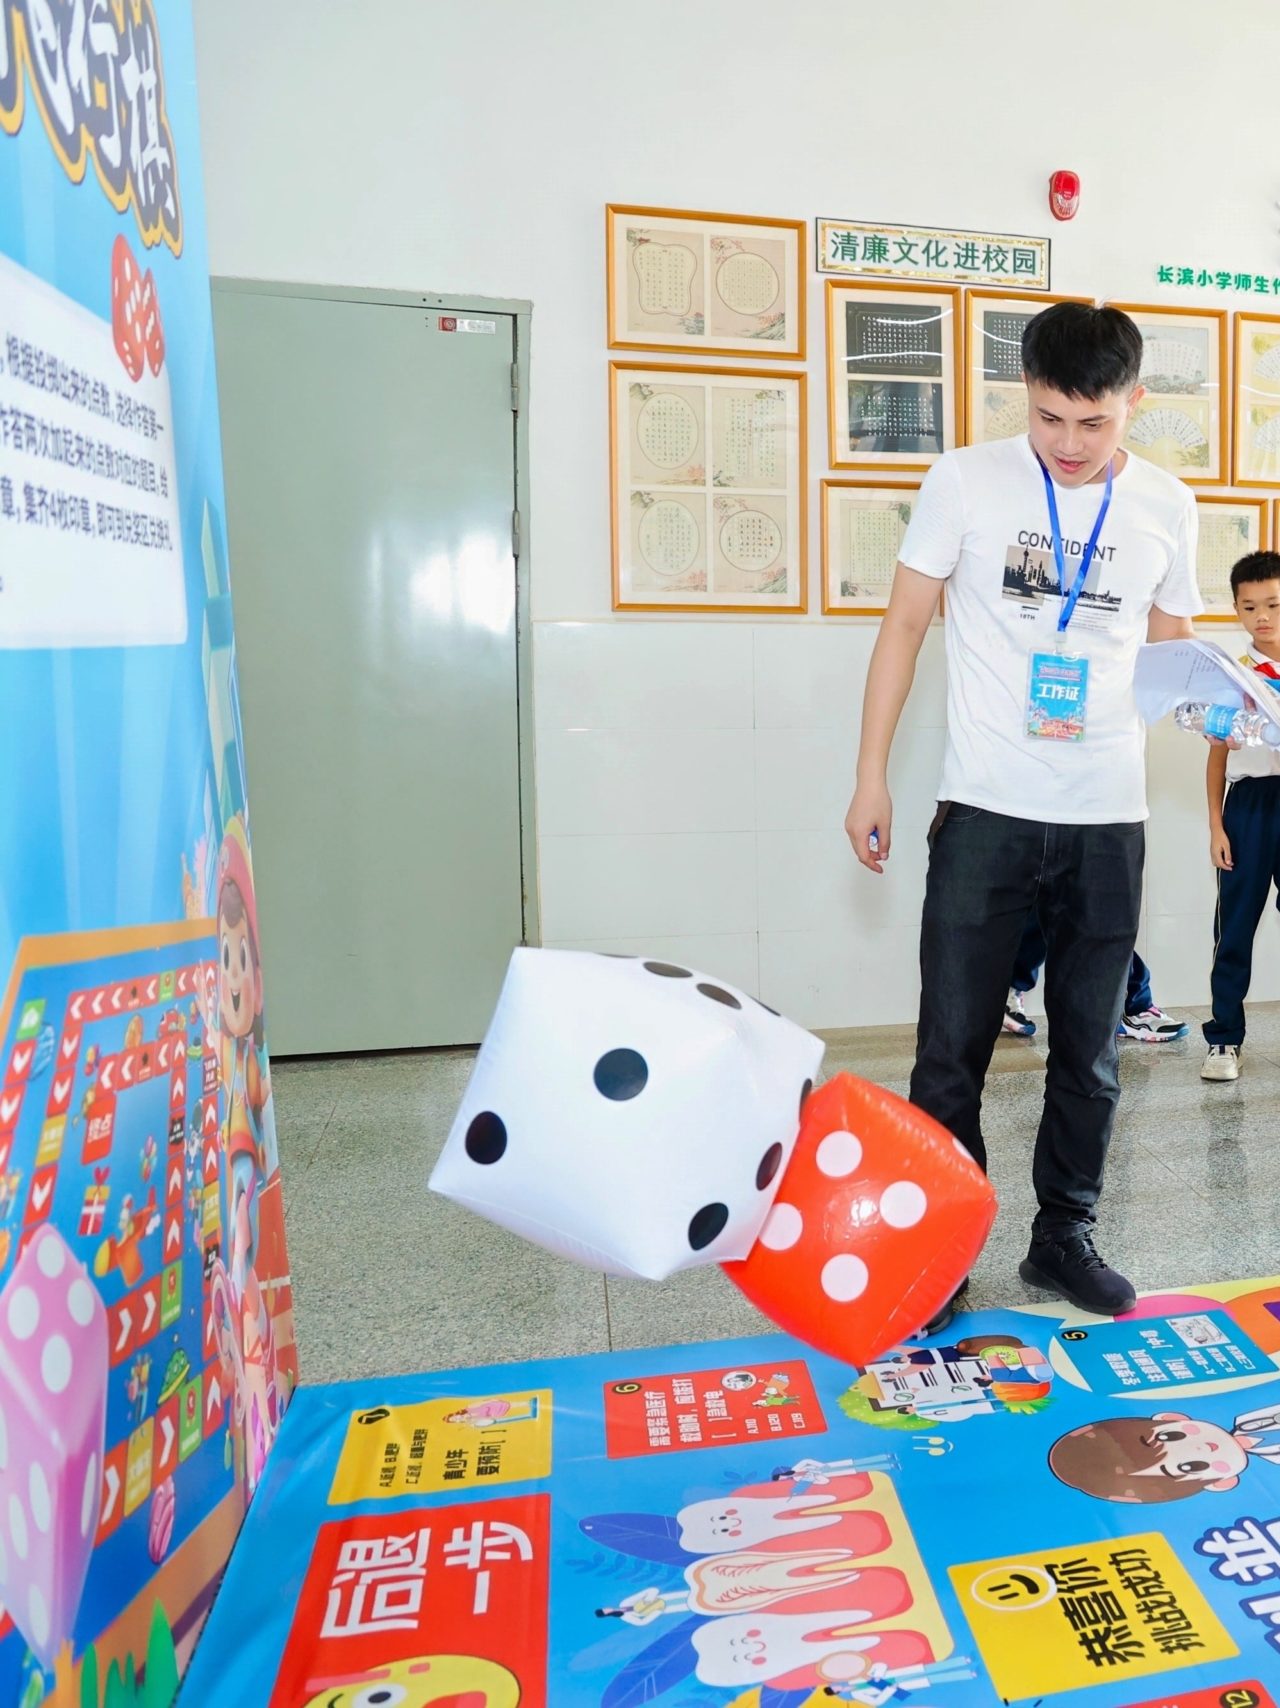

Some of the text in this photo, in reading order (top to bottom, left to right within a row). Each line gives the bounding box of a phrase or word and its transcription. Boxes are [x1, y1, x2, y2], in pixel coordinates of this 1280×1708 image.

[830, 231, 1037, 275] 清廉文化进校园
[1018, 531, 1116, 561] CONIDNT
[1037, 683, 1080, 701] 工作证
[1065, 1330, 1085, 1341] 5
[615, 1383, 639, 1394] 6
[360, 1413, 385, 1424] 7
[443, 1449, 467, 1480] 青少年
[319, 1527, 431, 1639] 后退
[443, 1520, 534, 1616] 一步
[1046, 1559, 1144, 1666] 恭喜你
[1110, 1549, 1203, 1654] 挑战成功
